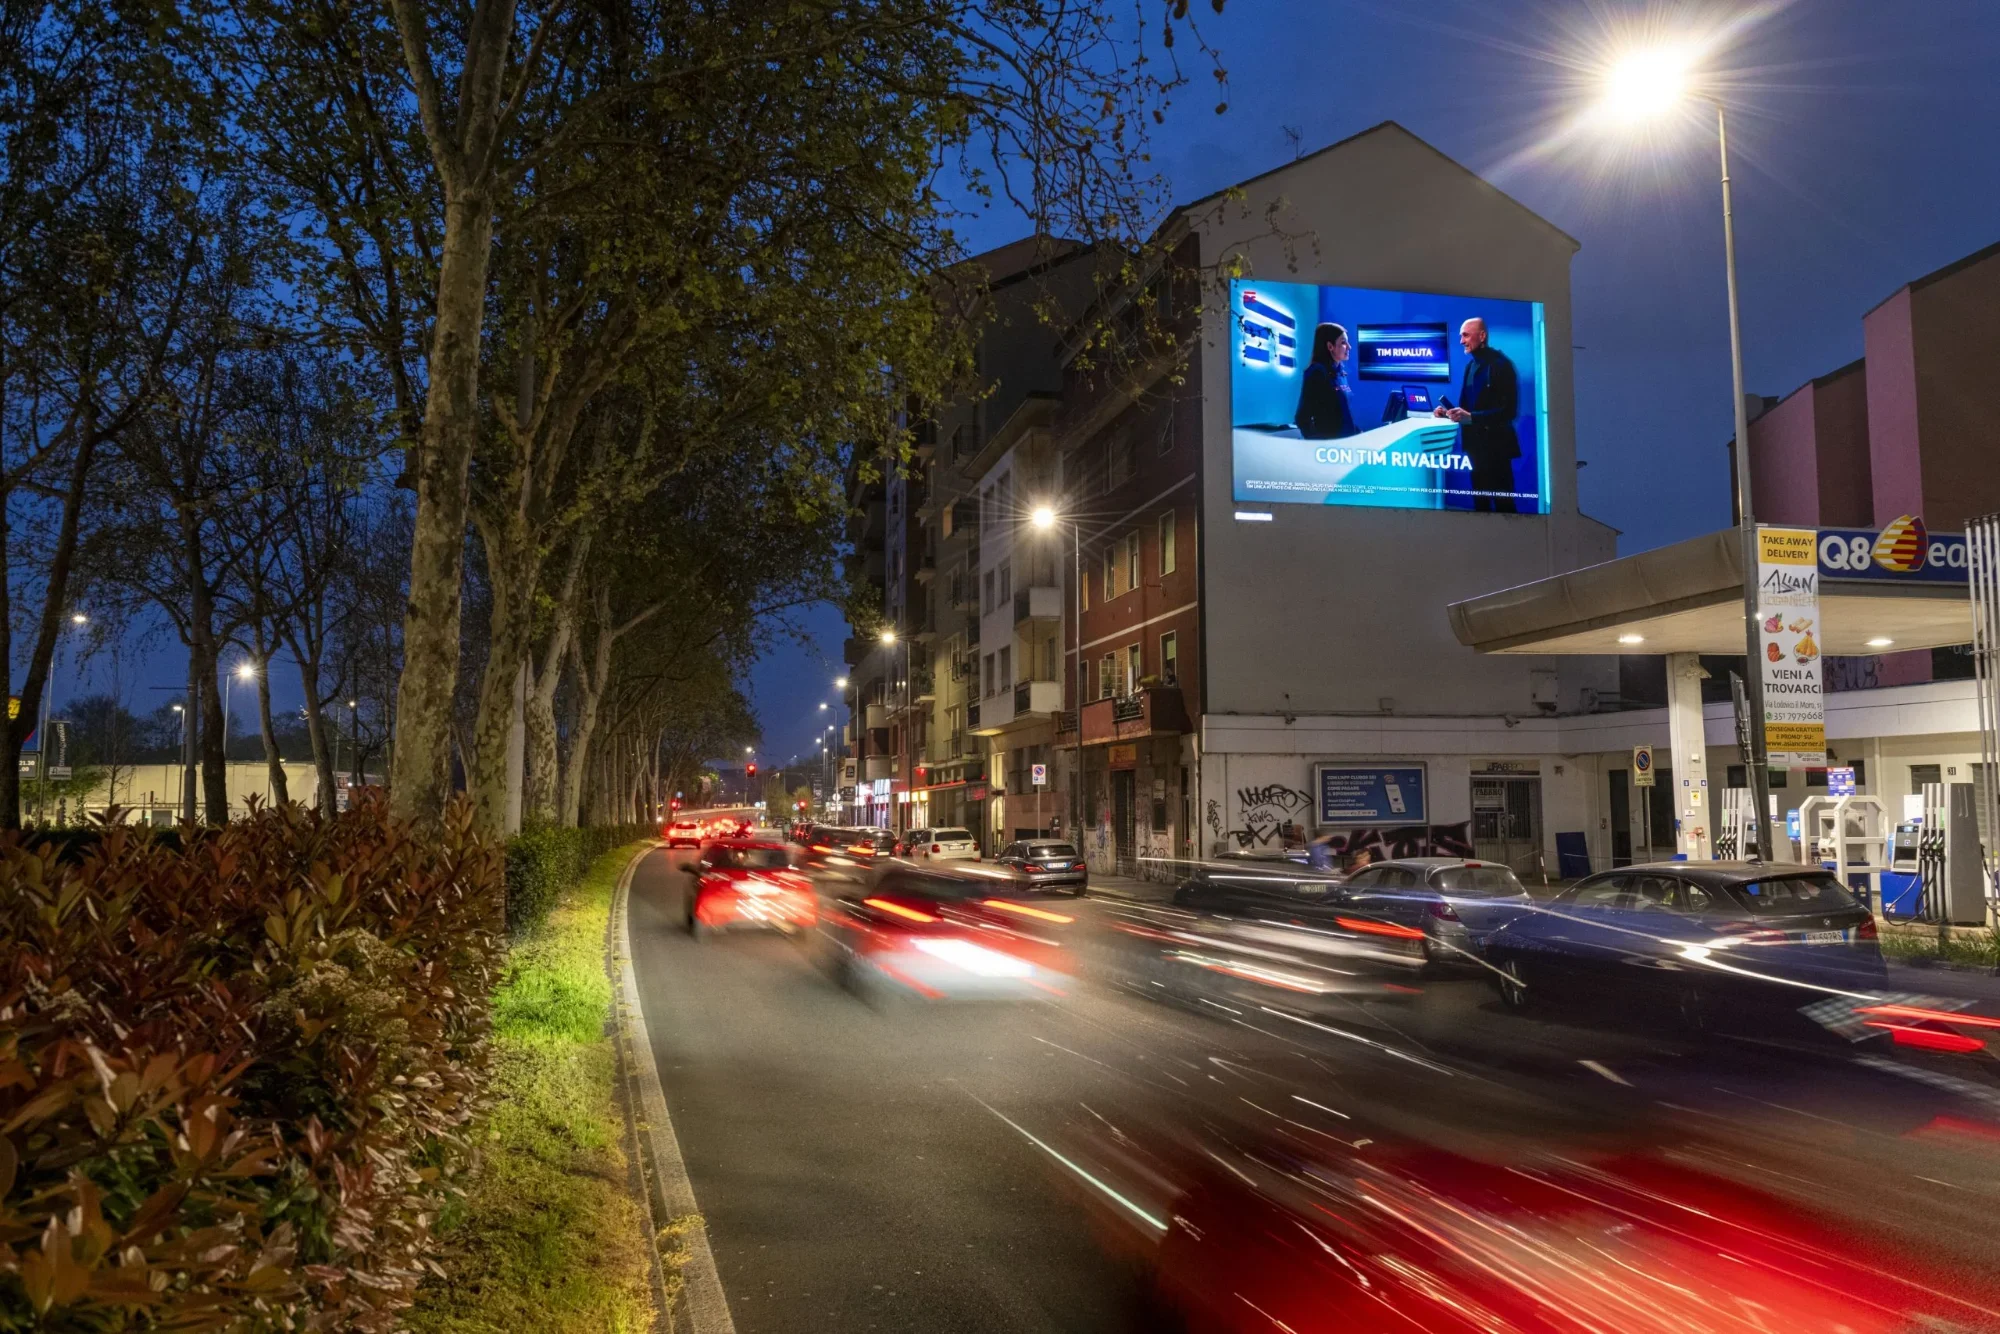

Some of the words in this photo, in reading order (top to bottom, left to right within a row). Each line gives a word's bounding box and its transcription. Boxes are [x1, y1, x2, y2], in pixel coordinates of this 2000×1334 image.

[1376, 348, 1392, 357] TIM
[1393, 348, 1433, 357] RIVALUTA
[1415, 395, 1427, 403] TIM
[1315, 447, 1353, 464] CON
[1356, 449, 1387, 466] TIM
[1391, 451, 1473, 471] RIVALUTA
[1762, 535, 1785, 546] TAKE
[1786, 536, 1814, 547] AWAY
[1767, 548, 1809, 559] DELIVERY
[1818, 535, 1871, 571] Q8
[1772, 669, 1802, 680] VIENI
[1805, 670, 1814, 680] A
[1765, 683, 1822, 694] TROVARCI
[1787, 711, 1824, 721] 7979668
